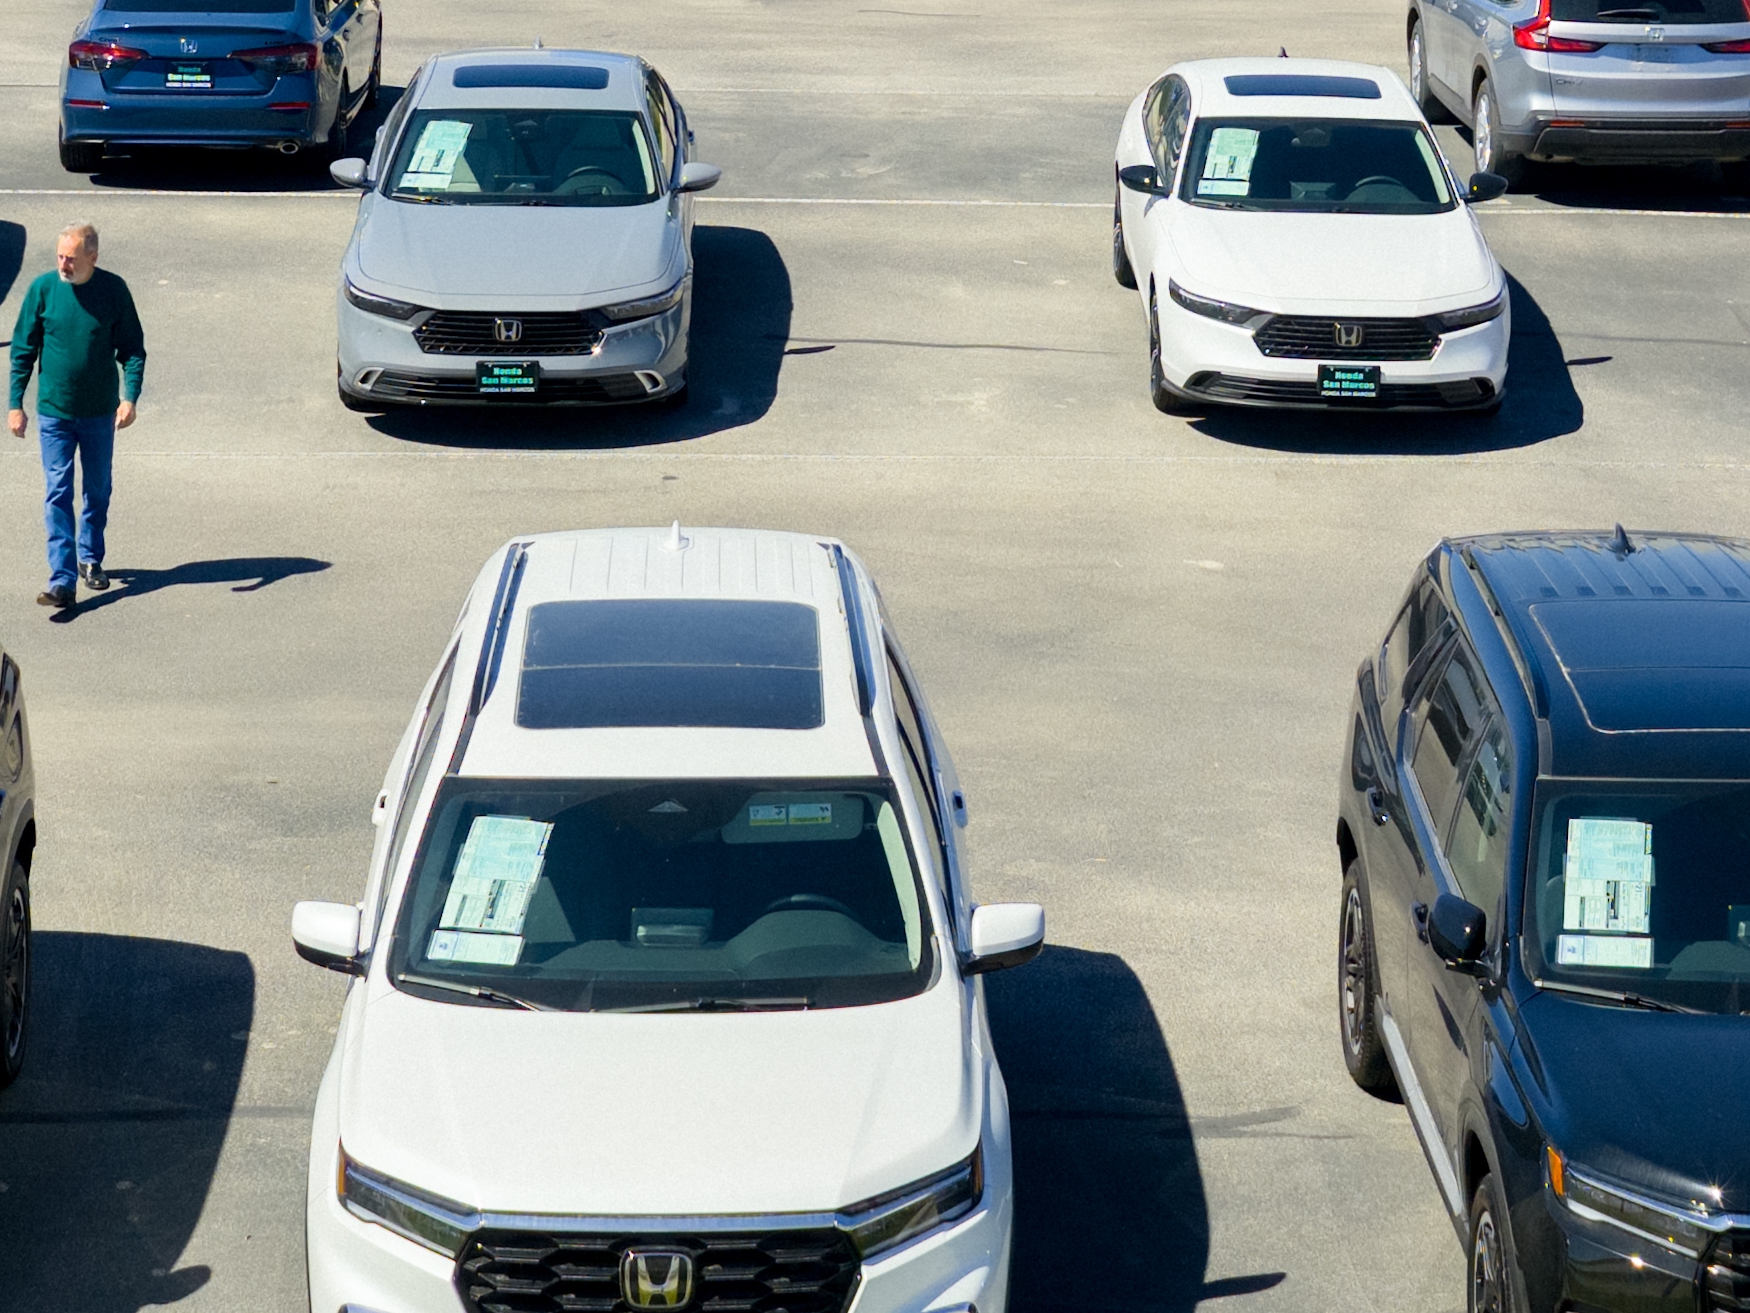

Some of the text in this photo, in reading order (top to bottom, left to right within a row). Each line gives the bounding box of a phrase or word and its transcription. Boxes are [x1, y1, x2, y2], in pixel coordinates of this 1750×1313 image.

[493, 367, 522, 375] Honda
[1334, 370, 1364, 380] Honda
[481, 376, 534, 384] San Marcos
[1322, 379, 1375, 390] San Marcos
